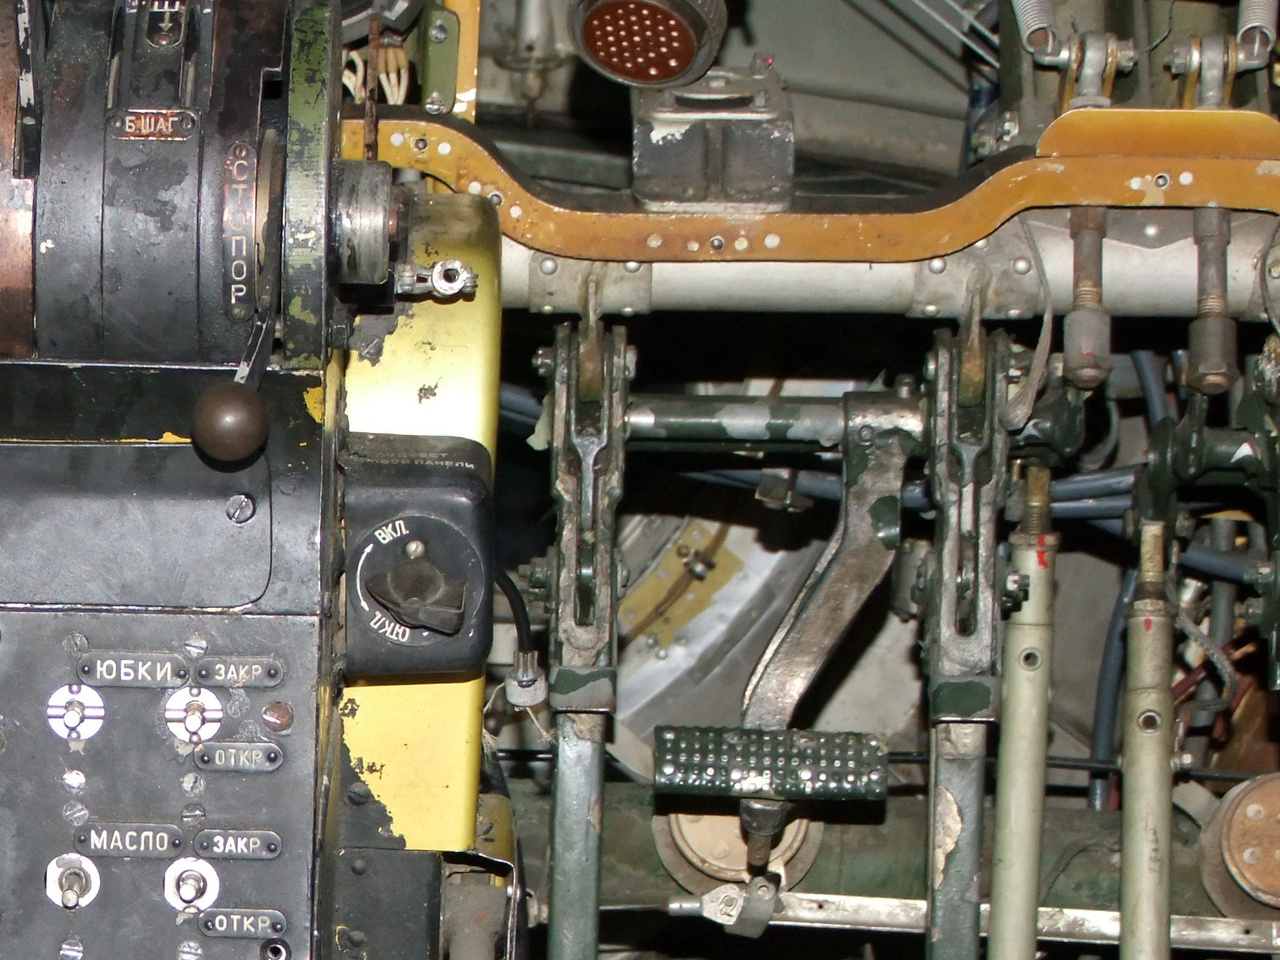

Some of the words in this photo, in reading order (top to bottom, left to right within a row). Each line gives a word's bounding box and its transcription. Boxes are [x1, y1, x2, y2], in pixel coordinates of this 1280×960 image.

[230, 160, 248, 304] СТОПОР
[96, 659, 172, 681] ЮБКИ
[90, 829, 168, 851] МАСЛО
